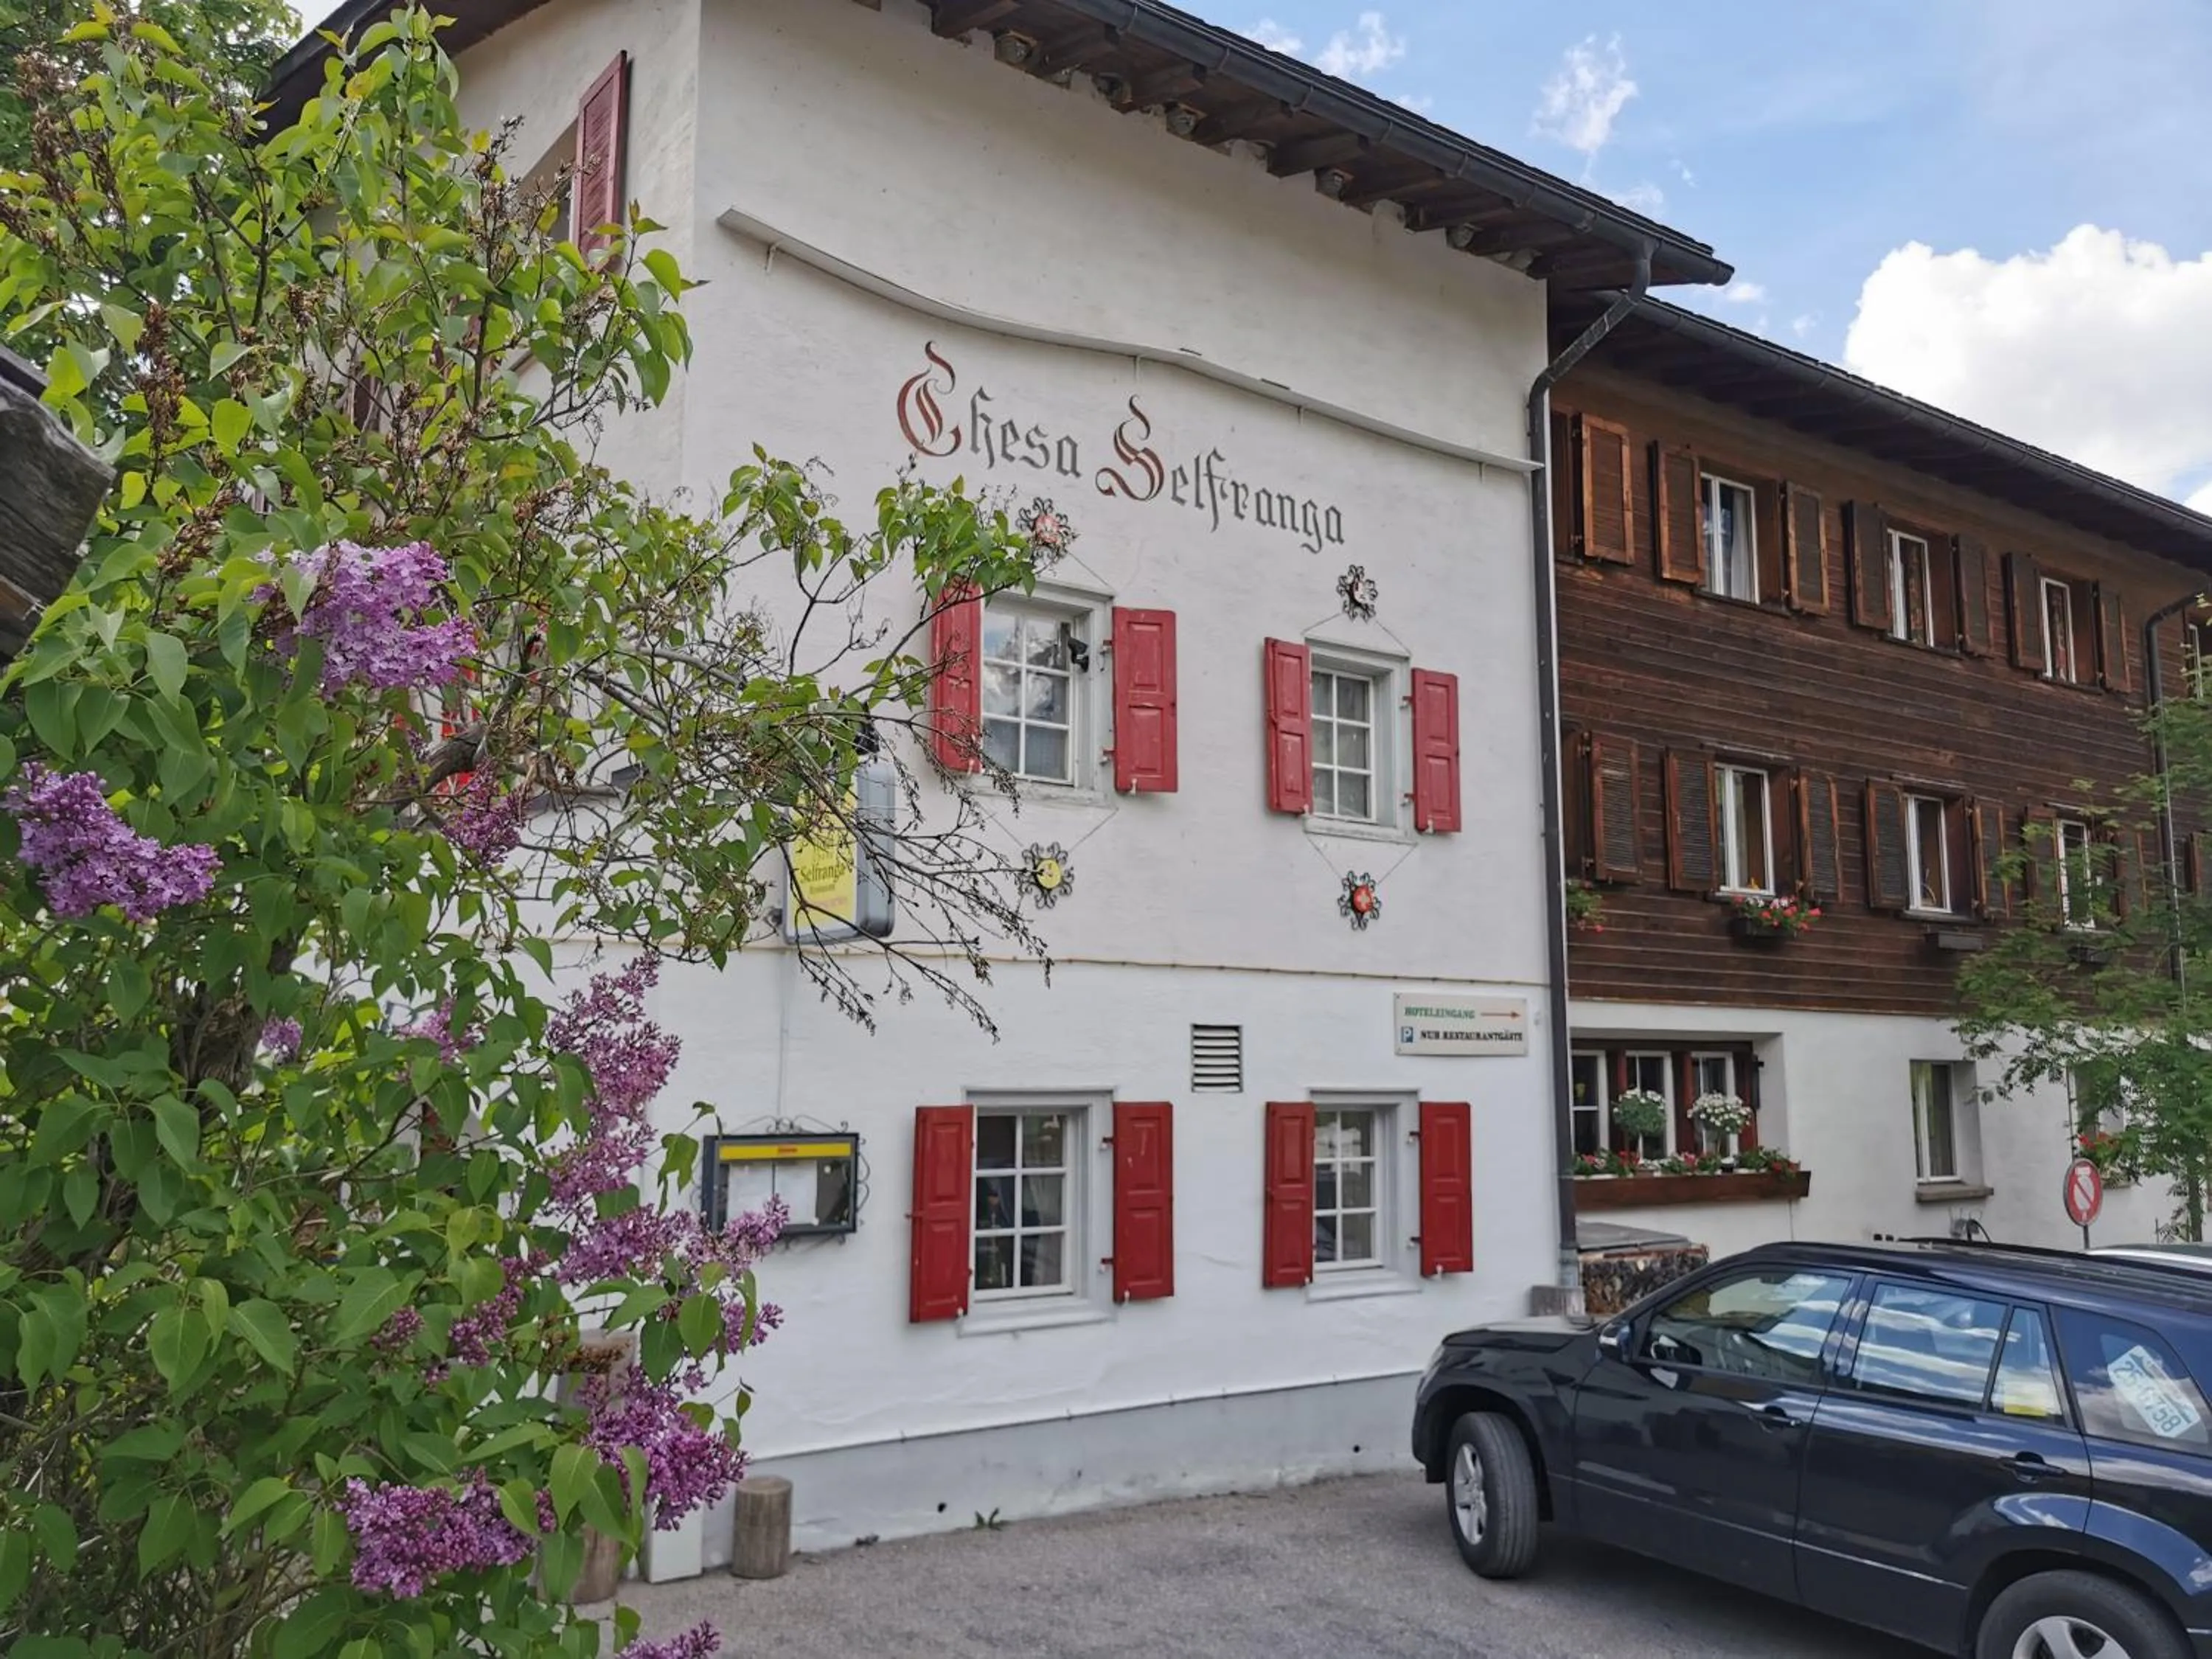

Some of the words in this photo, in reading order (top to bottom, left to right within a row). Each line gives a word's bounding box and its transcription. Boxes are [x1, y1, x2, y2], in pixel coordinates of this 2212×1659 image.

[897, 340, 1082, 479] Chesa
[1095, 394, 1345, 554] Selfranga
[1404, 1006, 1475, 1019] HOTELEINGANG
[1402, 1027, 1413, 1043] P
[1420, 1030, 1440, 1040] NUR
